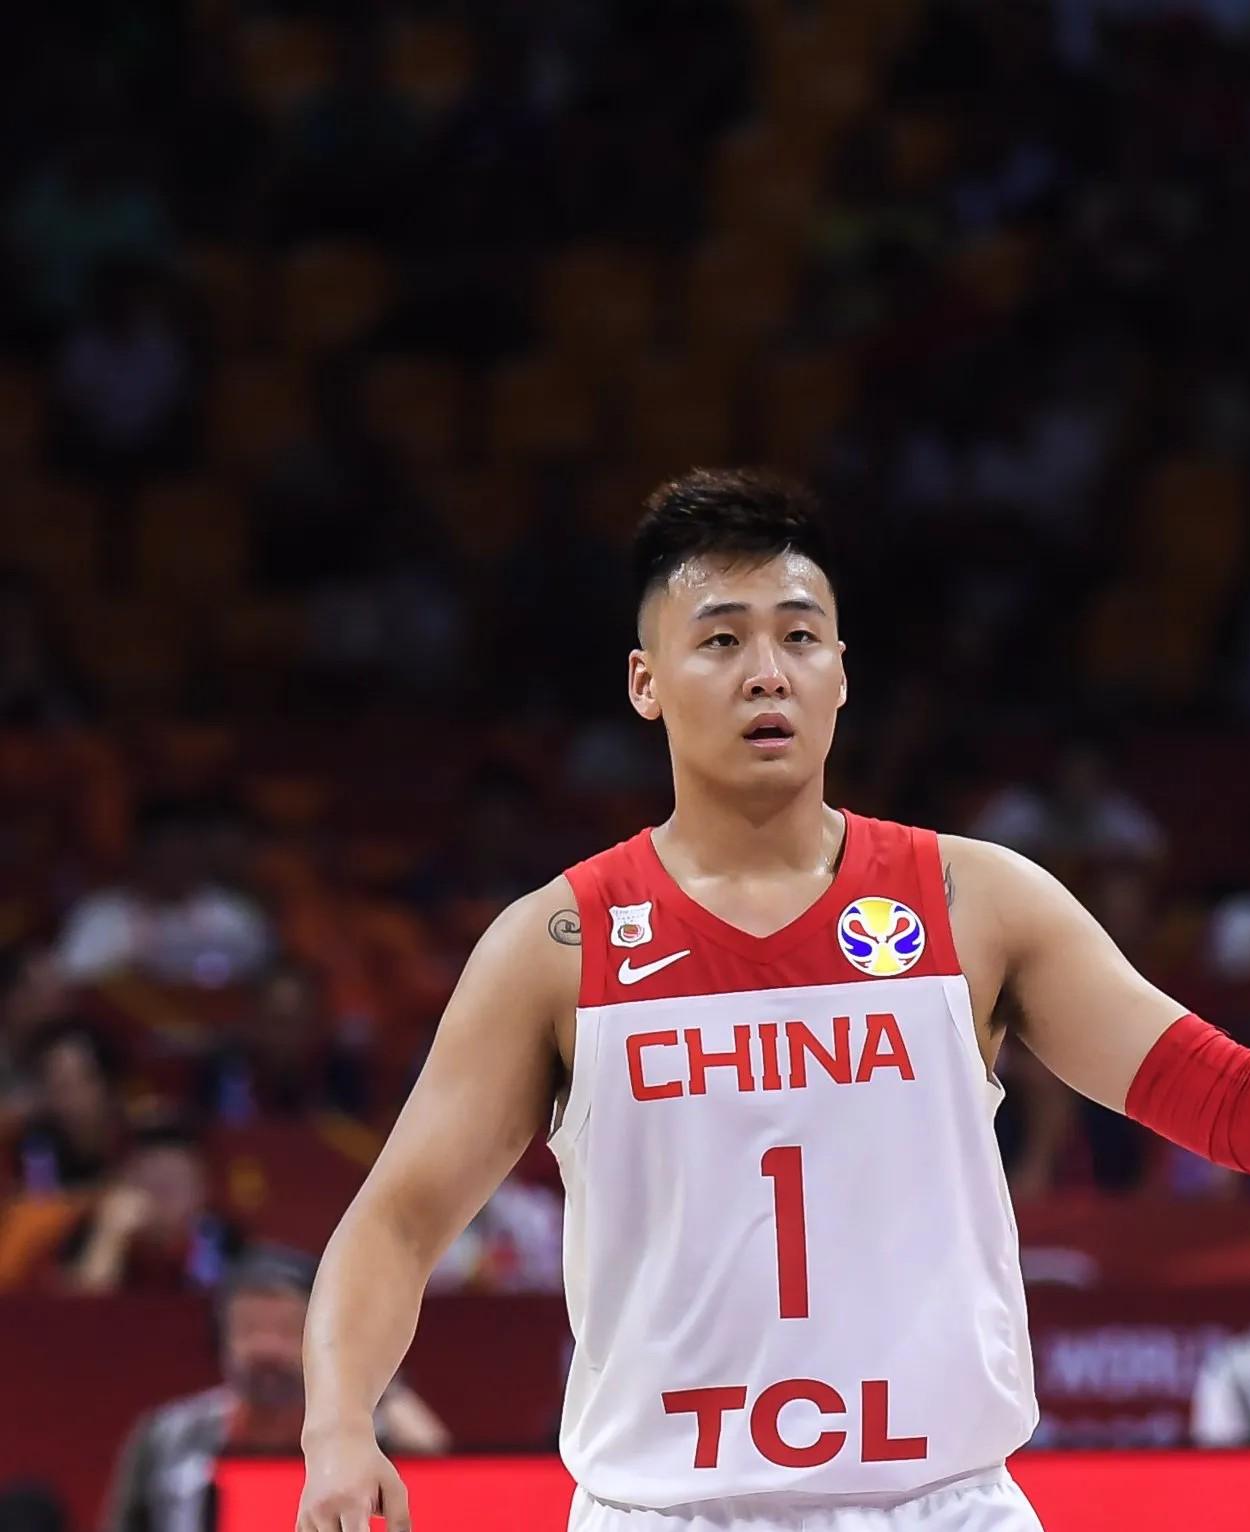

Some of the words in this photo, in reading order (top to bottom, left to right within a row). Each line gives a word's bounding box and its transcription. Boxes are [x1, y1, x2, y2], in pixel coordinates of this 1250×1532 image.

[626, 1013, 916, 1102] CHINA
[760, 1145, 809, 1319] 1
[661, 1378, 929, 1469] TCL
